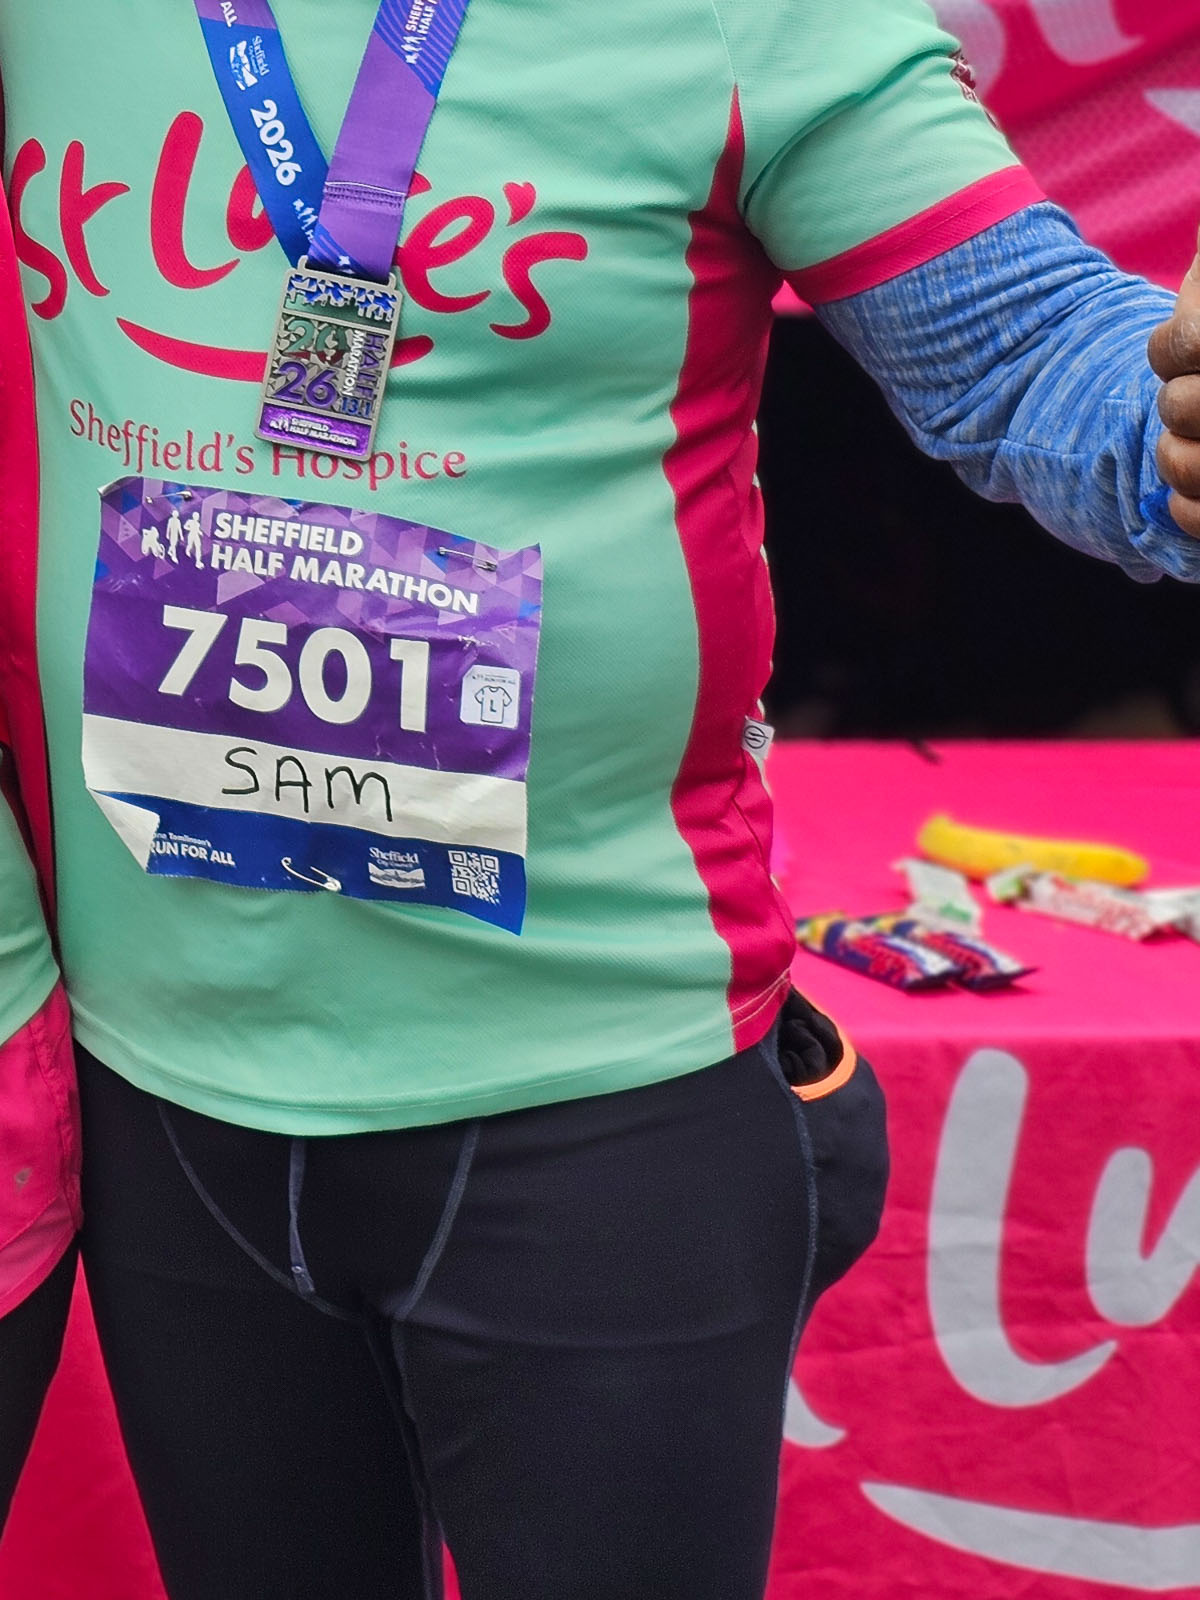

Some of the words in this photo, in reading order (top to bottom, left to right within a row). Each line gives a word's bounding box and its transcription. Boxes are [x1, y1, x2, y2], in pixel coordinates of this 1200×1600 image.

[220, 0, 239, 29] ALL
[416, 4, 436, 35] HALF
[251, 34, 271, 77] Sheffield
[250, 98, 303, 187] 2026
[10, 137, 131, 321] St
[149, 110, 589, 341] Lue's
[274, 360, 338, 409] 26
[341, 329, 365, 397] MARATHON
[356, 332, 386, 400] HALF
[340, 396, 372, 418] 13.1
[68, 398, 256, 474] Sheffield's
[271, 440, 468, 493] Hospice
[214, 512, 364, 557] SHEFFIELD
[210, 541, 286, 579] HALF
[290, 558, 479, 616] MARATHON
[157, 604, 431, 734] 7501
[490, 699, 497, 713] L
[221, 745, 394, 822] SAM
[181, 843, 208, 861] FOR
[210, 849, 236, 867] ALL
[369, 846, 419, 865] Sheffield
